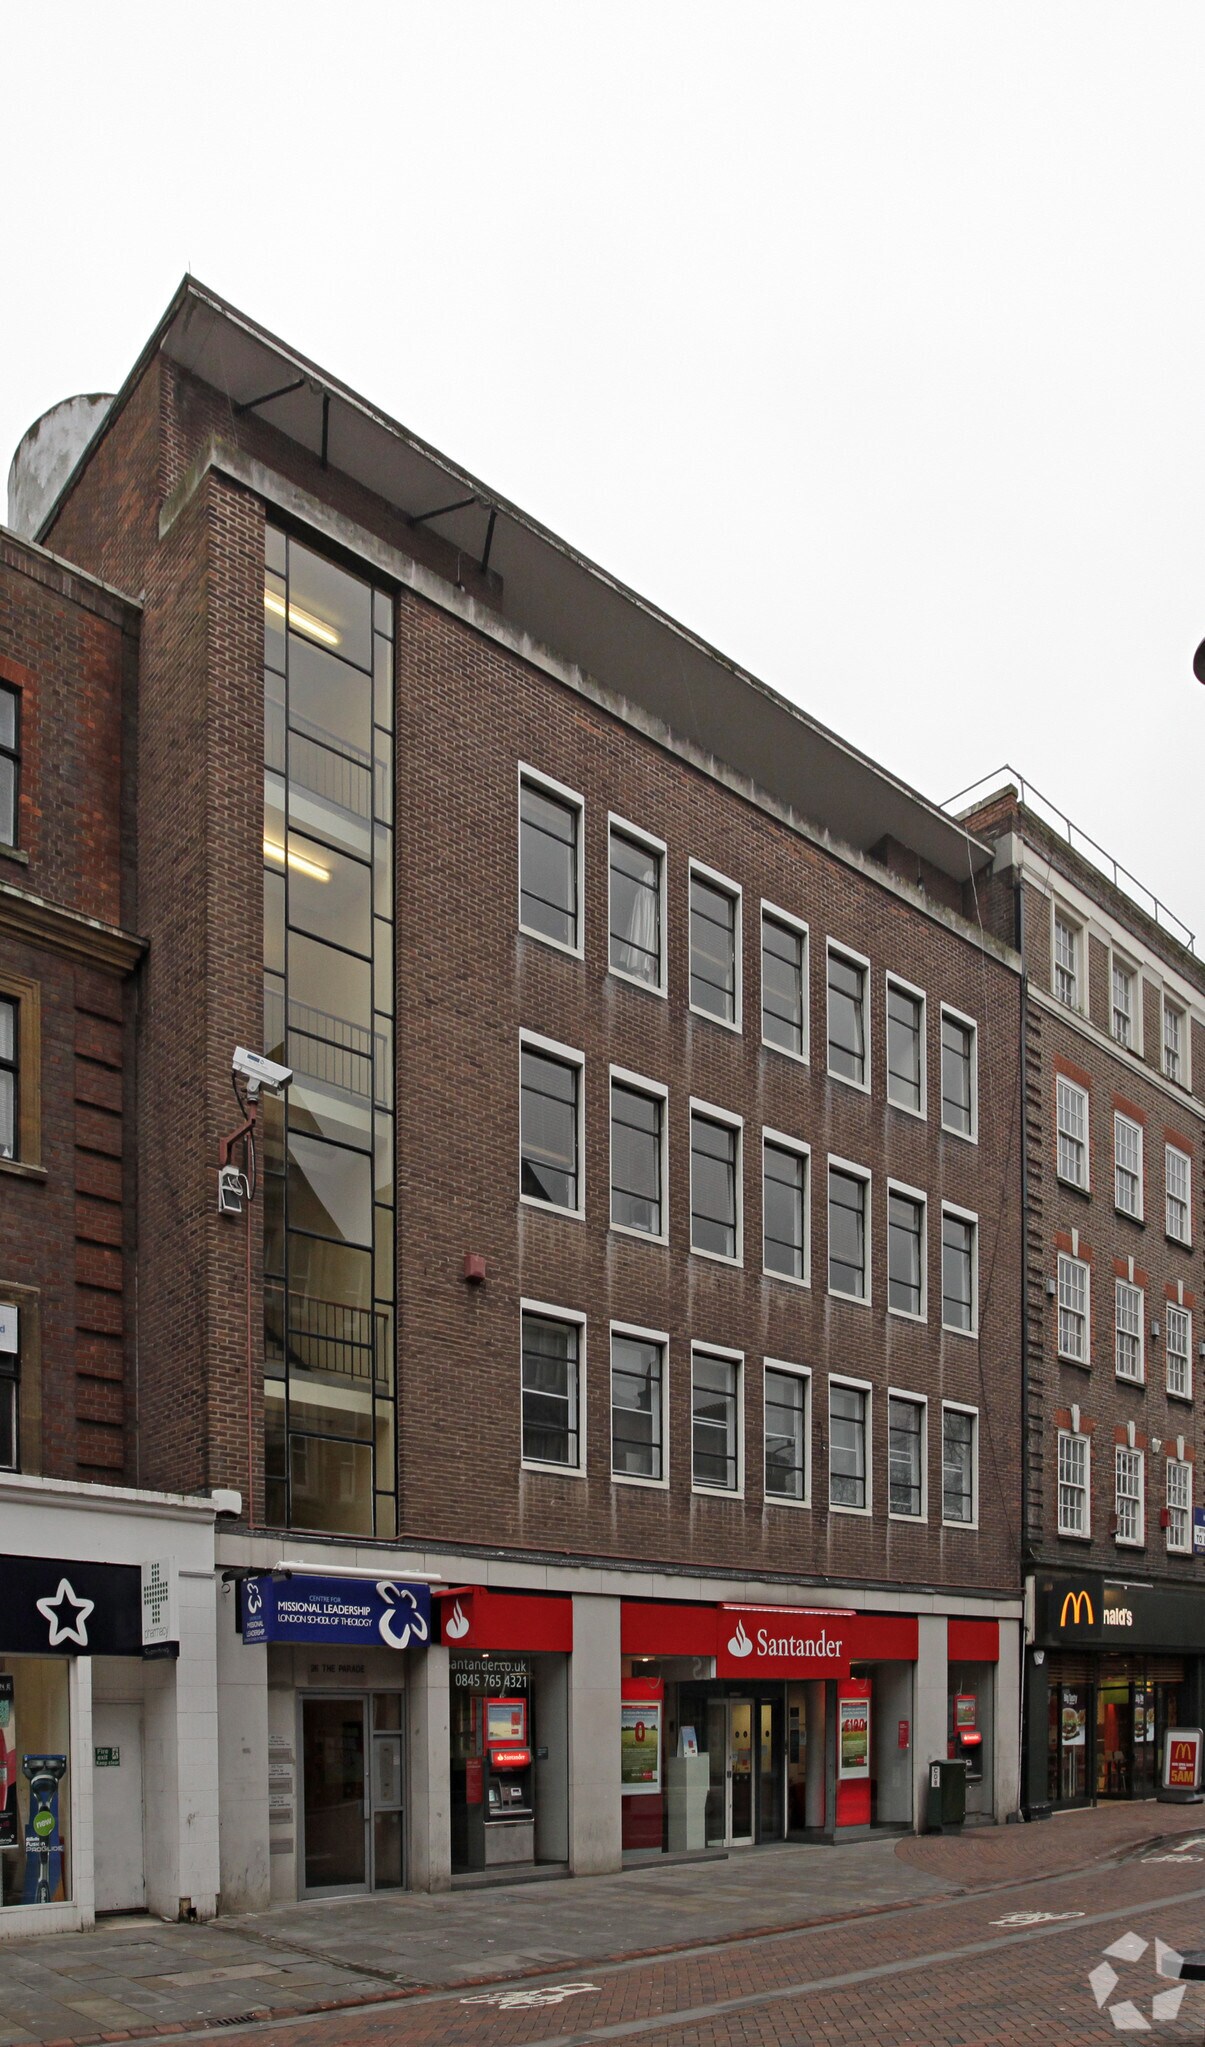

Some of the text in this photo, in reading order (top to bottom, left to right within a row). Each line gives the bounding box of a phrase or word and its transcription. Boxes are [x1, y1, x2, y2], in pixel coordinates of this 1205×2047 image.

[277, 1601, 371, 1616] MISSIONAL LEADERSHIP
[278, 1614, 372, 1626] LONDON SCHOOL OF THEOLOGY
[1103, 1608, 1133, 1627] nald's
[756, 1629, 842, 1657] Santander
[322, 1664, 335, 1672] THE
[339, 1664, 364, 1673] PARADE
[455, 1673, 527, 1688] 0845 765 4321
[504, 1753, 525, 1761] Santander
[1171, 1770, 1194, 1783] 5AM
[36, 1818, 52, 1828] new
